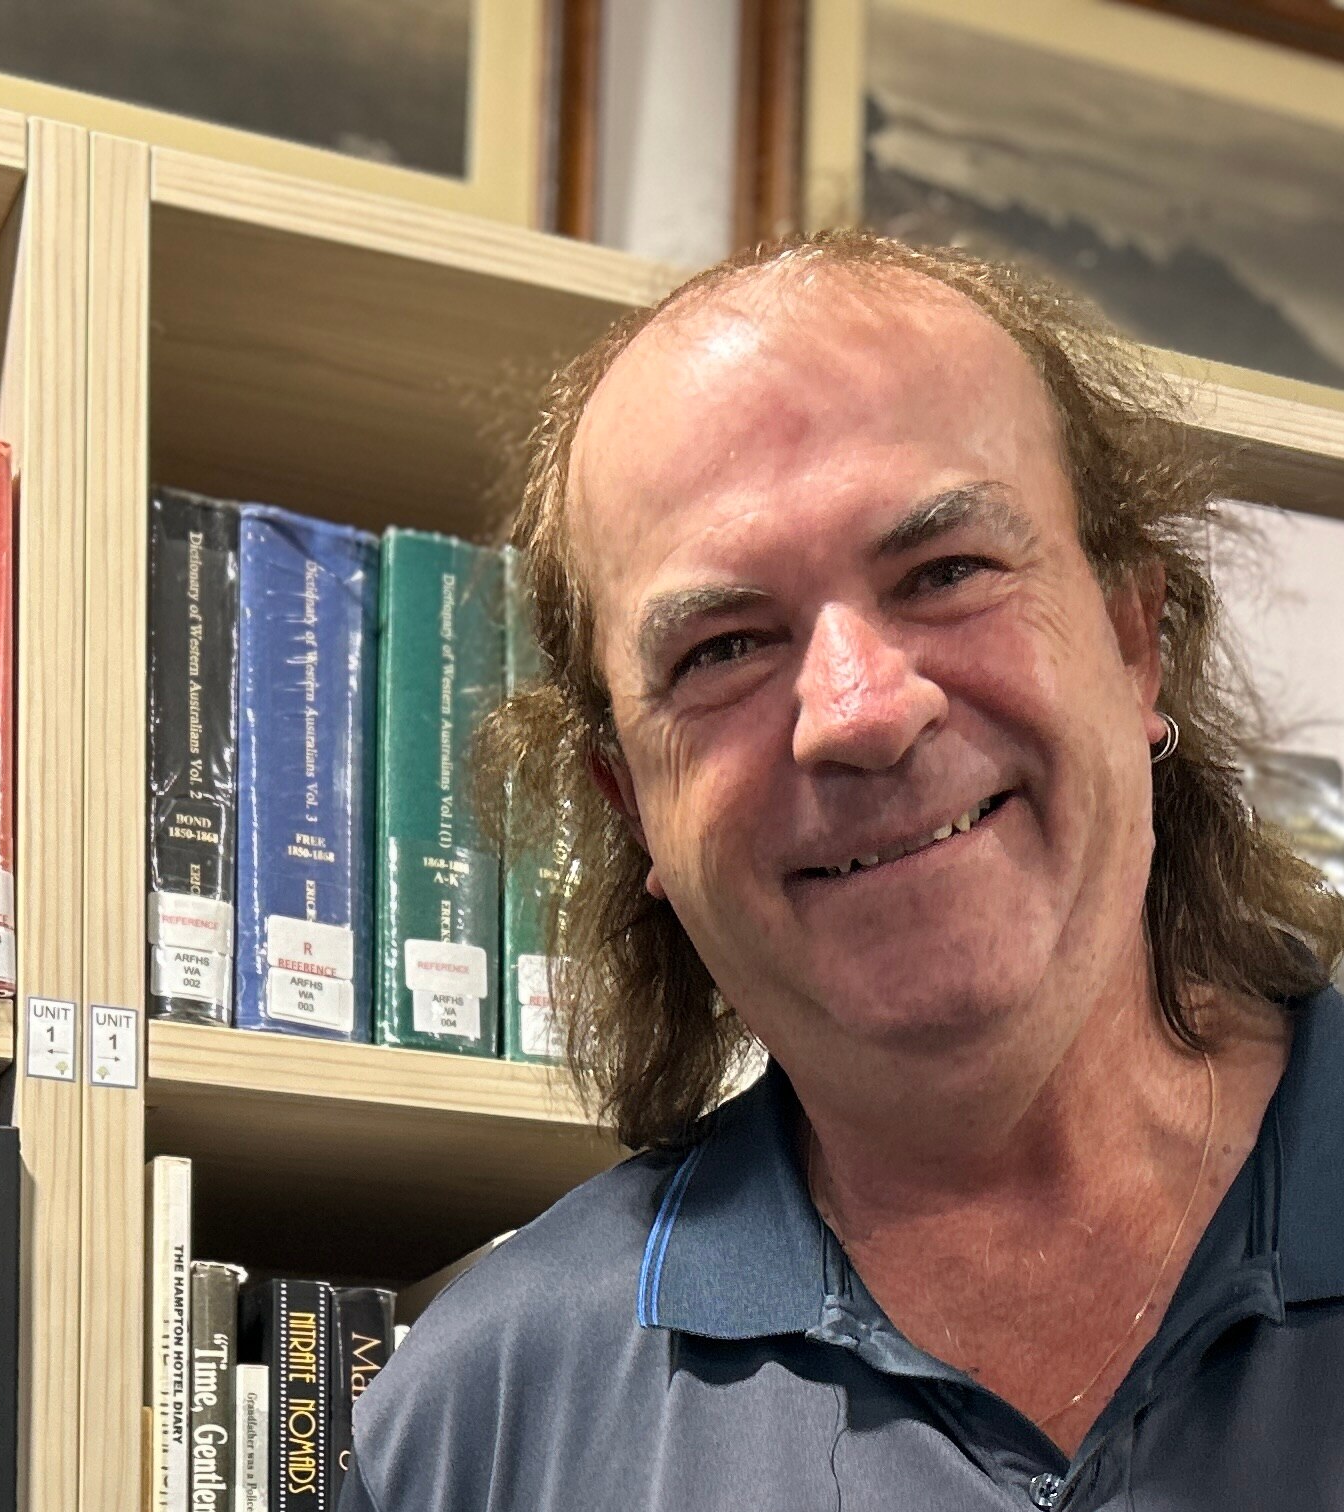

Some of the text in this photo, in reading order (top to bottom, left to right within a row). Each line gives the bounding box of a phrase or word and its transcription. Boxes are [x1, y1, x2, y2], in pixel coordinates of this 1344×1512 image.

[186, 532, 203, 800] Dictionary of Western Australians Vol. 2
[176, 814, 212, 829] BOND
[34, 1005, 71, 1020] UNIT
[96, 1013, 132, 1028] UNIT
[47, 1026, 54, 1042] 1
[109, 1034, 116, 1049] 1
[172, 1245, 184, 1444] THE HAMPTON HOTEL DIARY
[288, 1311, 316, 1494] NITRATE NOMADS
